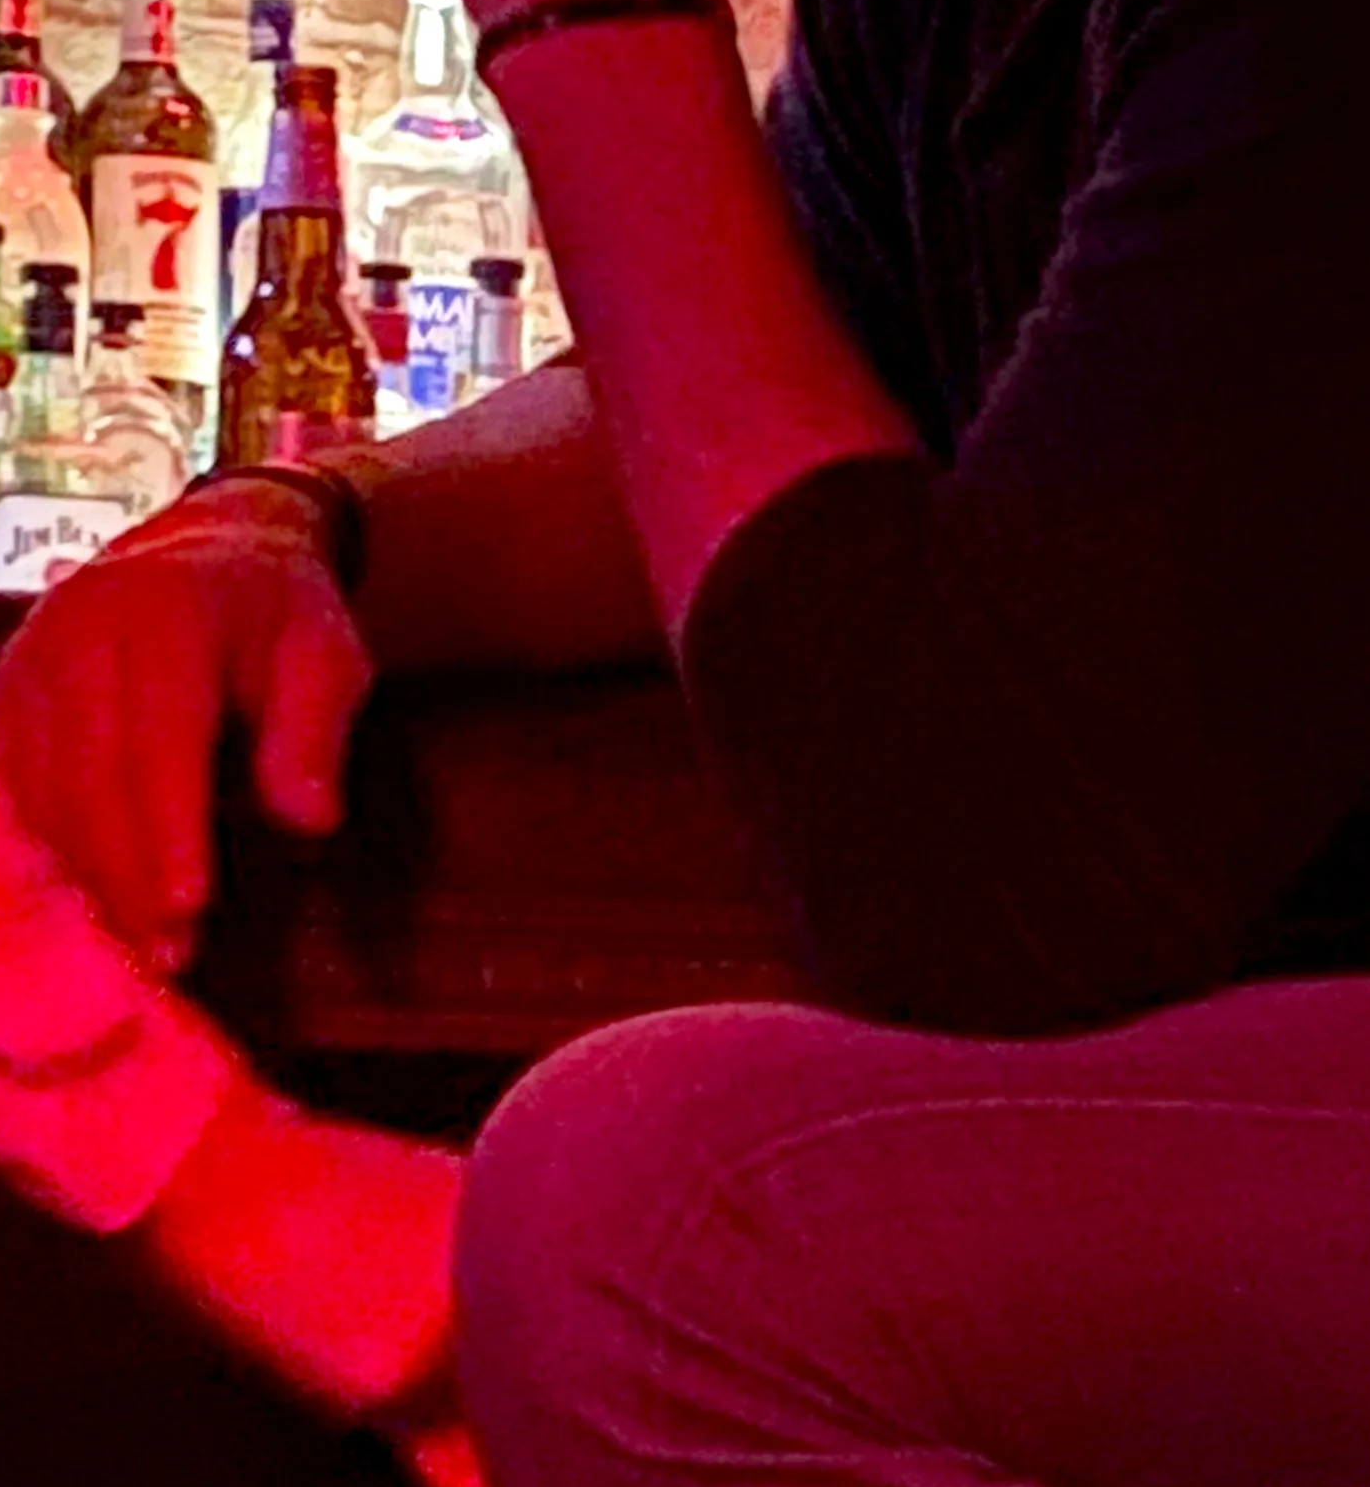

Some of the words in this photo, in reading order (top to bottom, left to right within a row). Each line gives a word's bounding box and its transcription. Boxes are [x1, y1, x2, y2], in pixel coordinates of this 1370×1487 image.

[135, 197, 200, 291] 7
[4, 525, 52, 566] JIM
[57, 515, 107, 553] BEA
